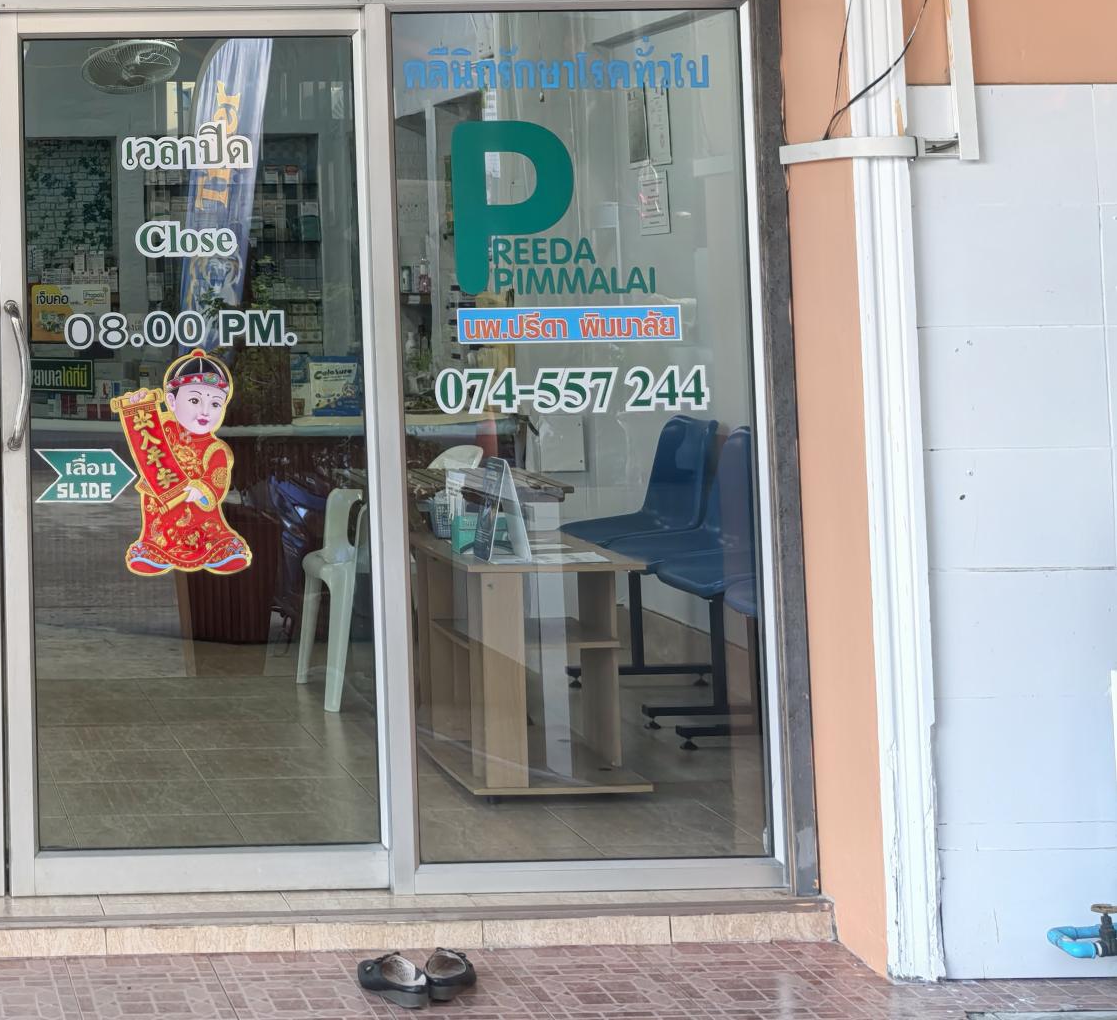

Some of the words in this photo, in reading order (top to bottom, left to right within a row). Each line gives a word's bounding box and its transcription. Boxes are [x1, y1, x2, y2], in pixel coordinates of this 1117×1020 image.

[121, 121, 254, 170] เวลาปิด
[135, 221, 238, 258] Close
[493, 266, 656, 295] PIMMALAI
[64, 311, 206, 349] 08.00
[218, 310, 298, 347] PM.
[464, 312, 569, 340] นพ.ปรีดา
[579, 310, 677, 337] พิมมาลัย
[436, 367, 618, 414] 074-557
[625, 365, 710, 411] 244
[66, 453, 116, 476] เลื่อน
[133, 409, 180, 489] 出入平安
[57, 482, 112, 499] SLIDE
